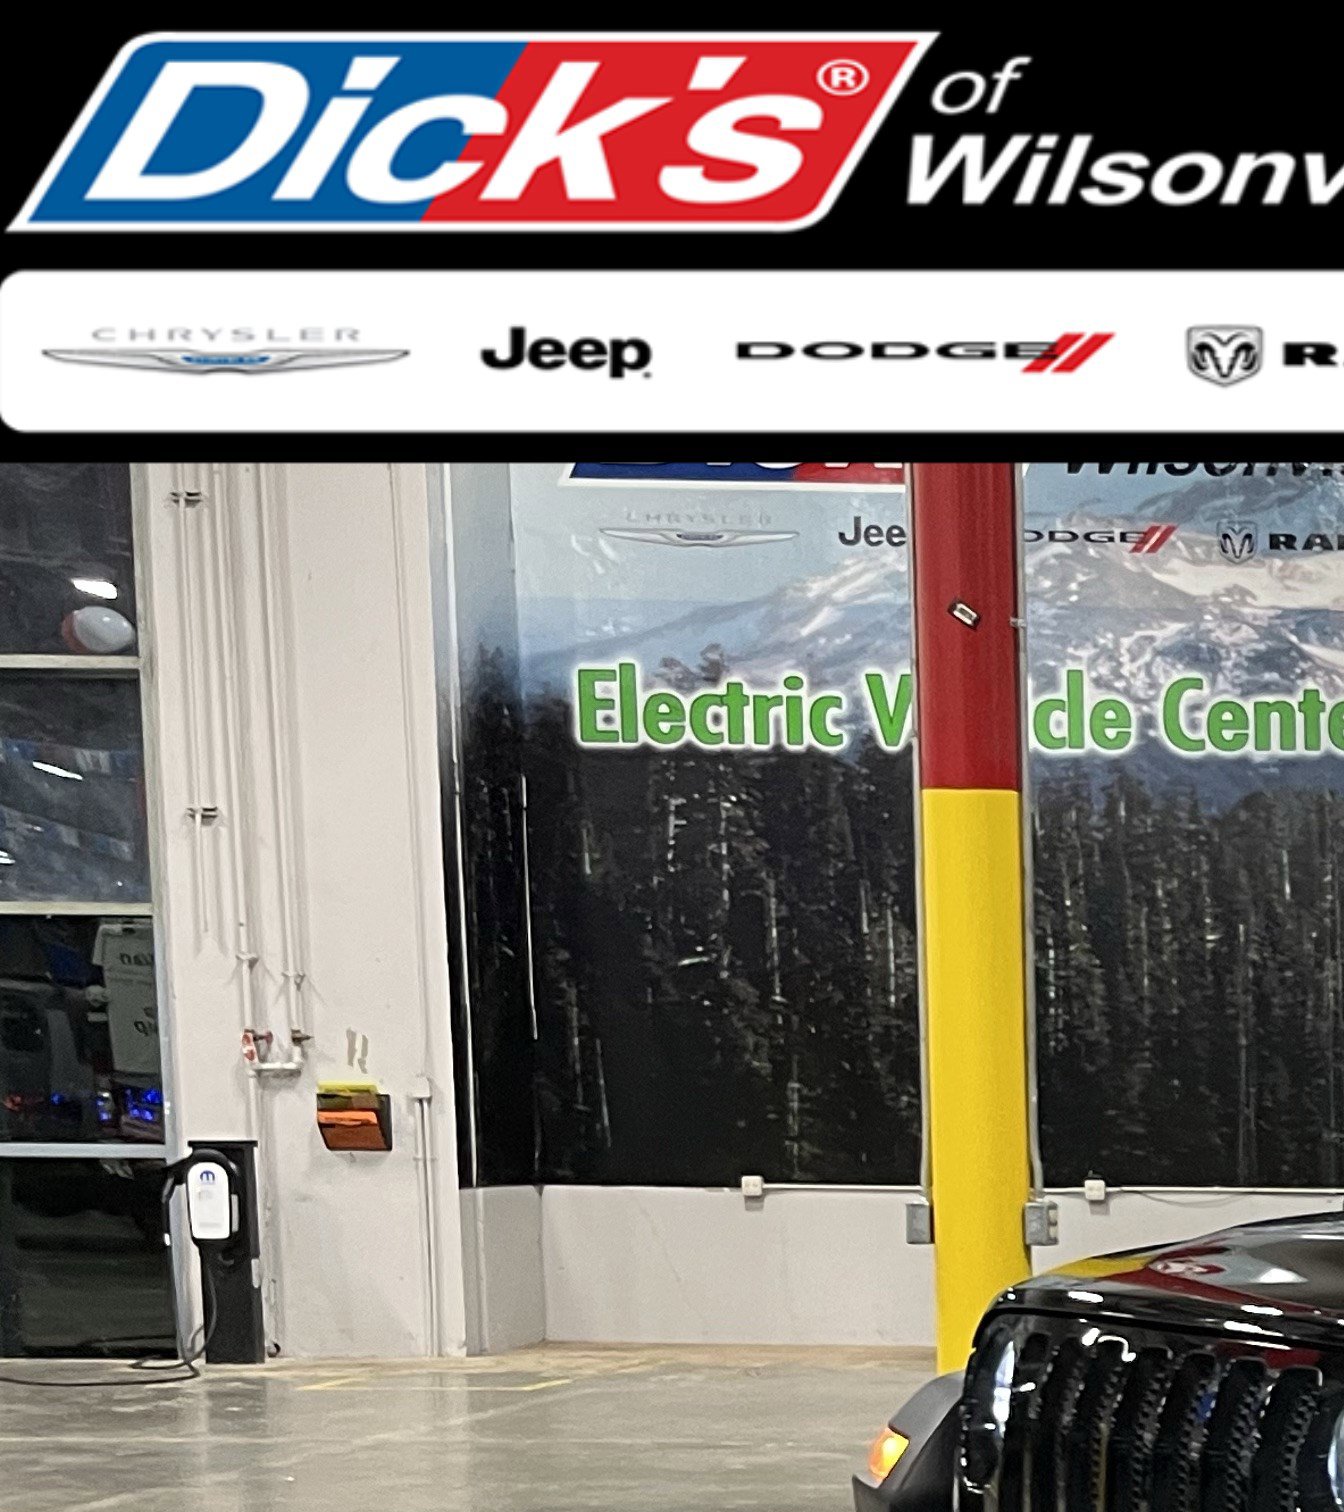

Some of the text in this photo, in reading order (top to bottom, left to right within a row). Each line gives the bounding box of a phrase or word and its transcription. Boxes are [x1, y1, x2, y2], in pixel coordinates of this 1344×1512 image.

[838, 516, 909, 547] Jee
[1024, 530, 1148, 544] ODGE
[578, 662, 843, 746] Electric
[866, 670, 1131, 750] Vcle
